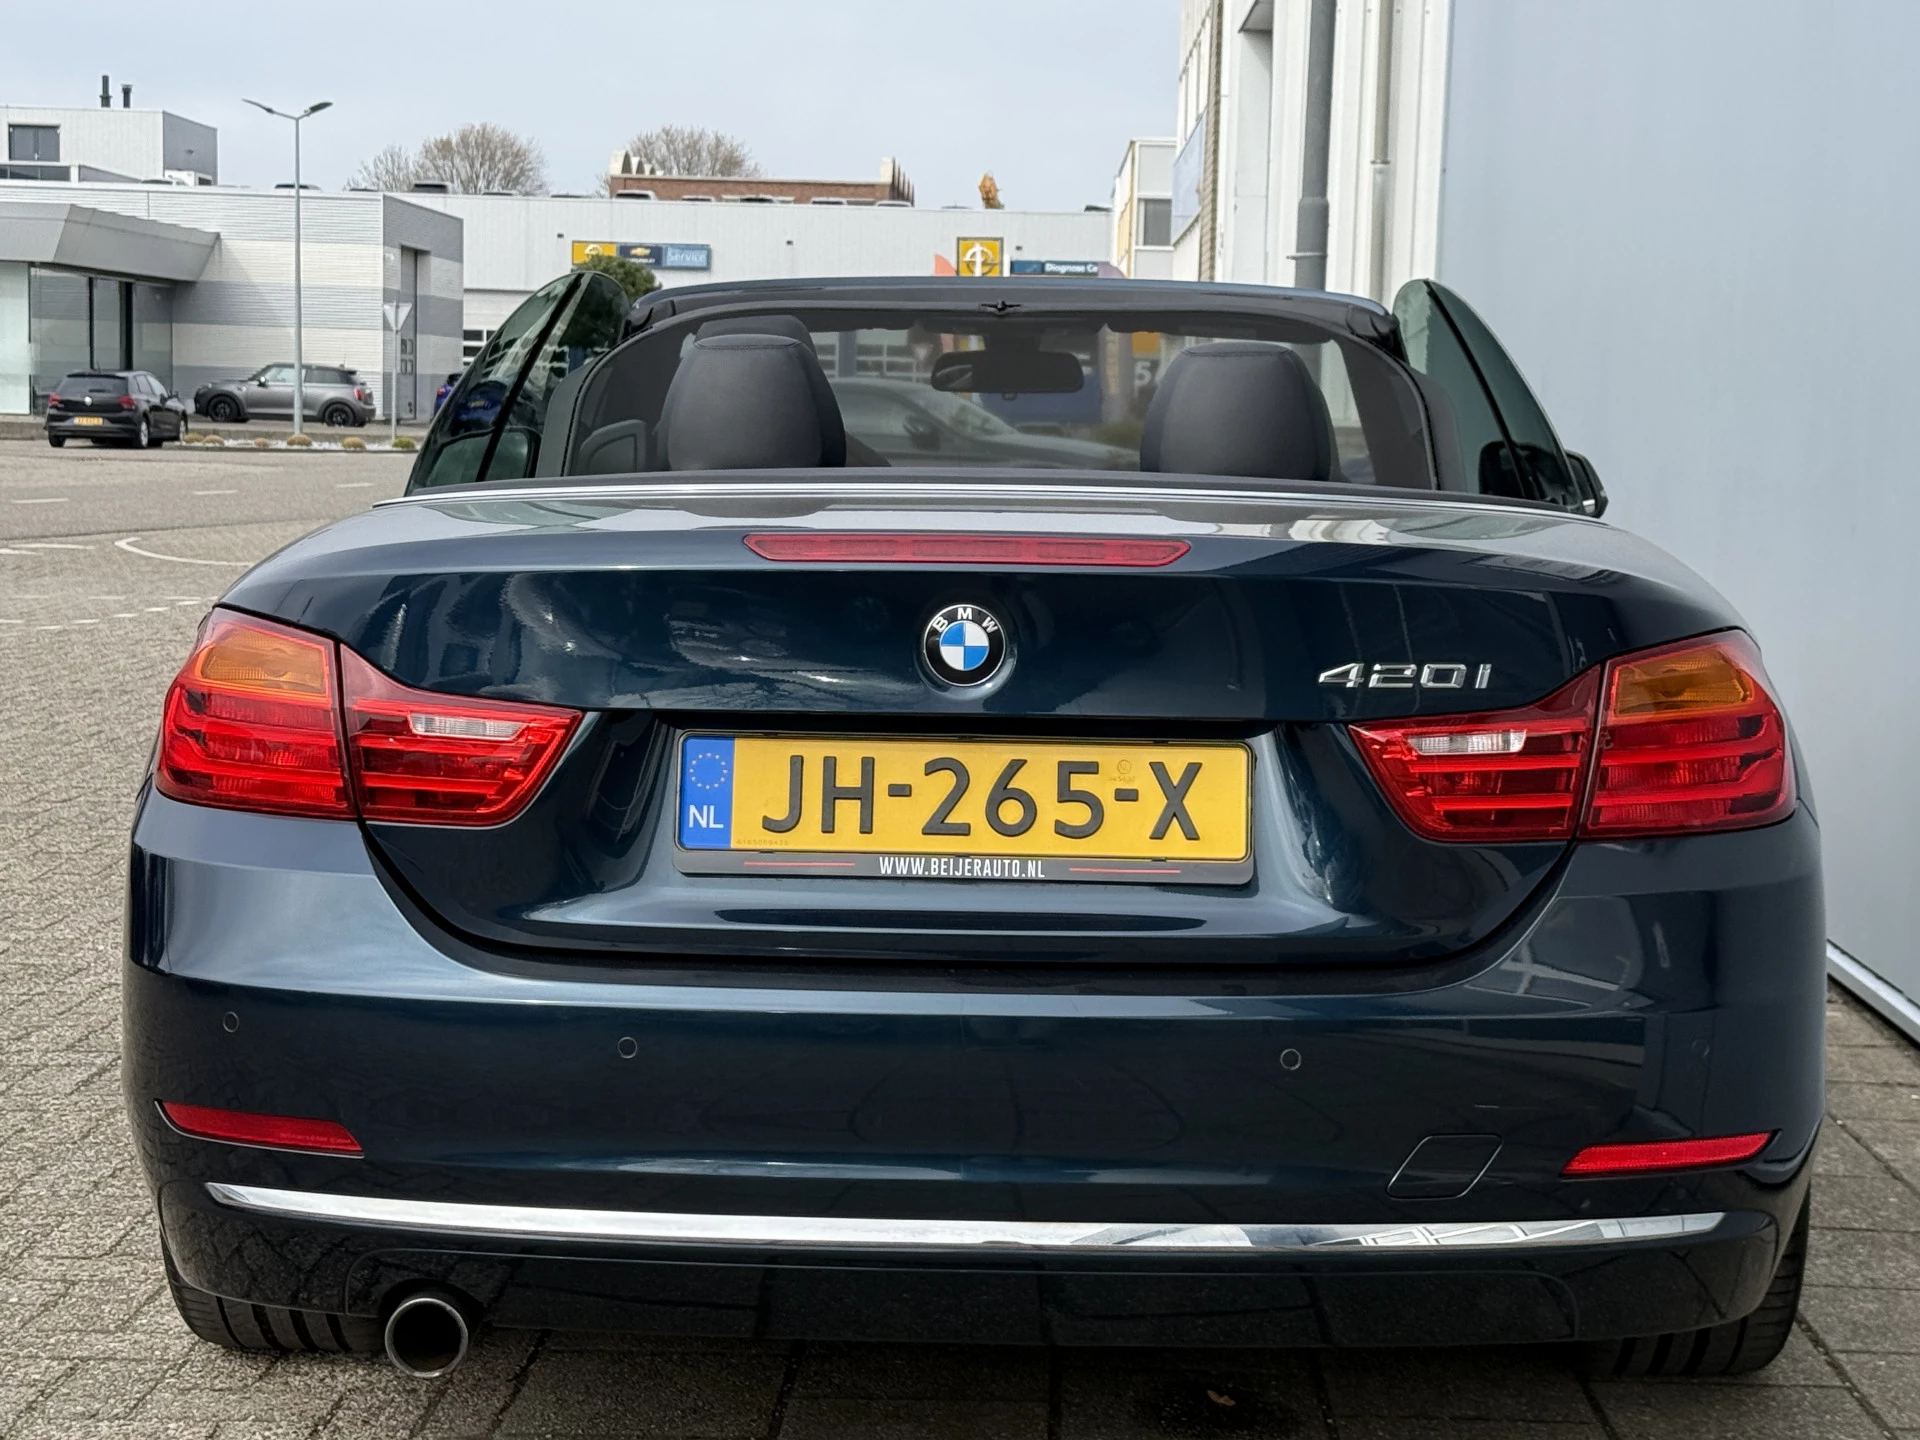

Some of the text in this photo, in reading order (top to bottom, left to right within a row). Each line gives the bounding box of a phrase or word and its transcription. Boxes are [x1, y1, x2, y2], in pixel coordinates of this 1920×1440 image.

[932, 607, 999, 634] BMW
[761, 754, 1203, 841] JH-265-X
[688, 804, 724, 829] NL
[879, 856, 1046, 878] WWW.BEIJERAUTO.NL
